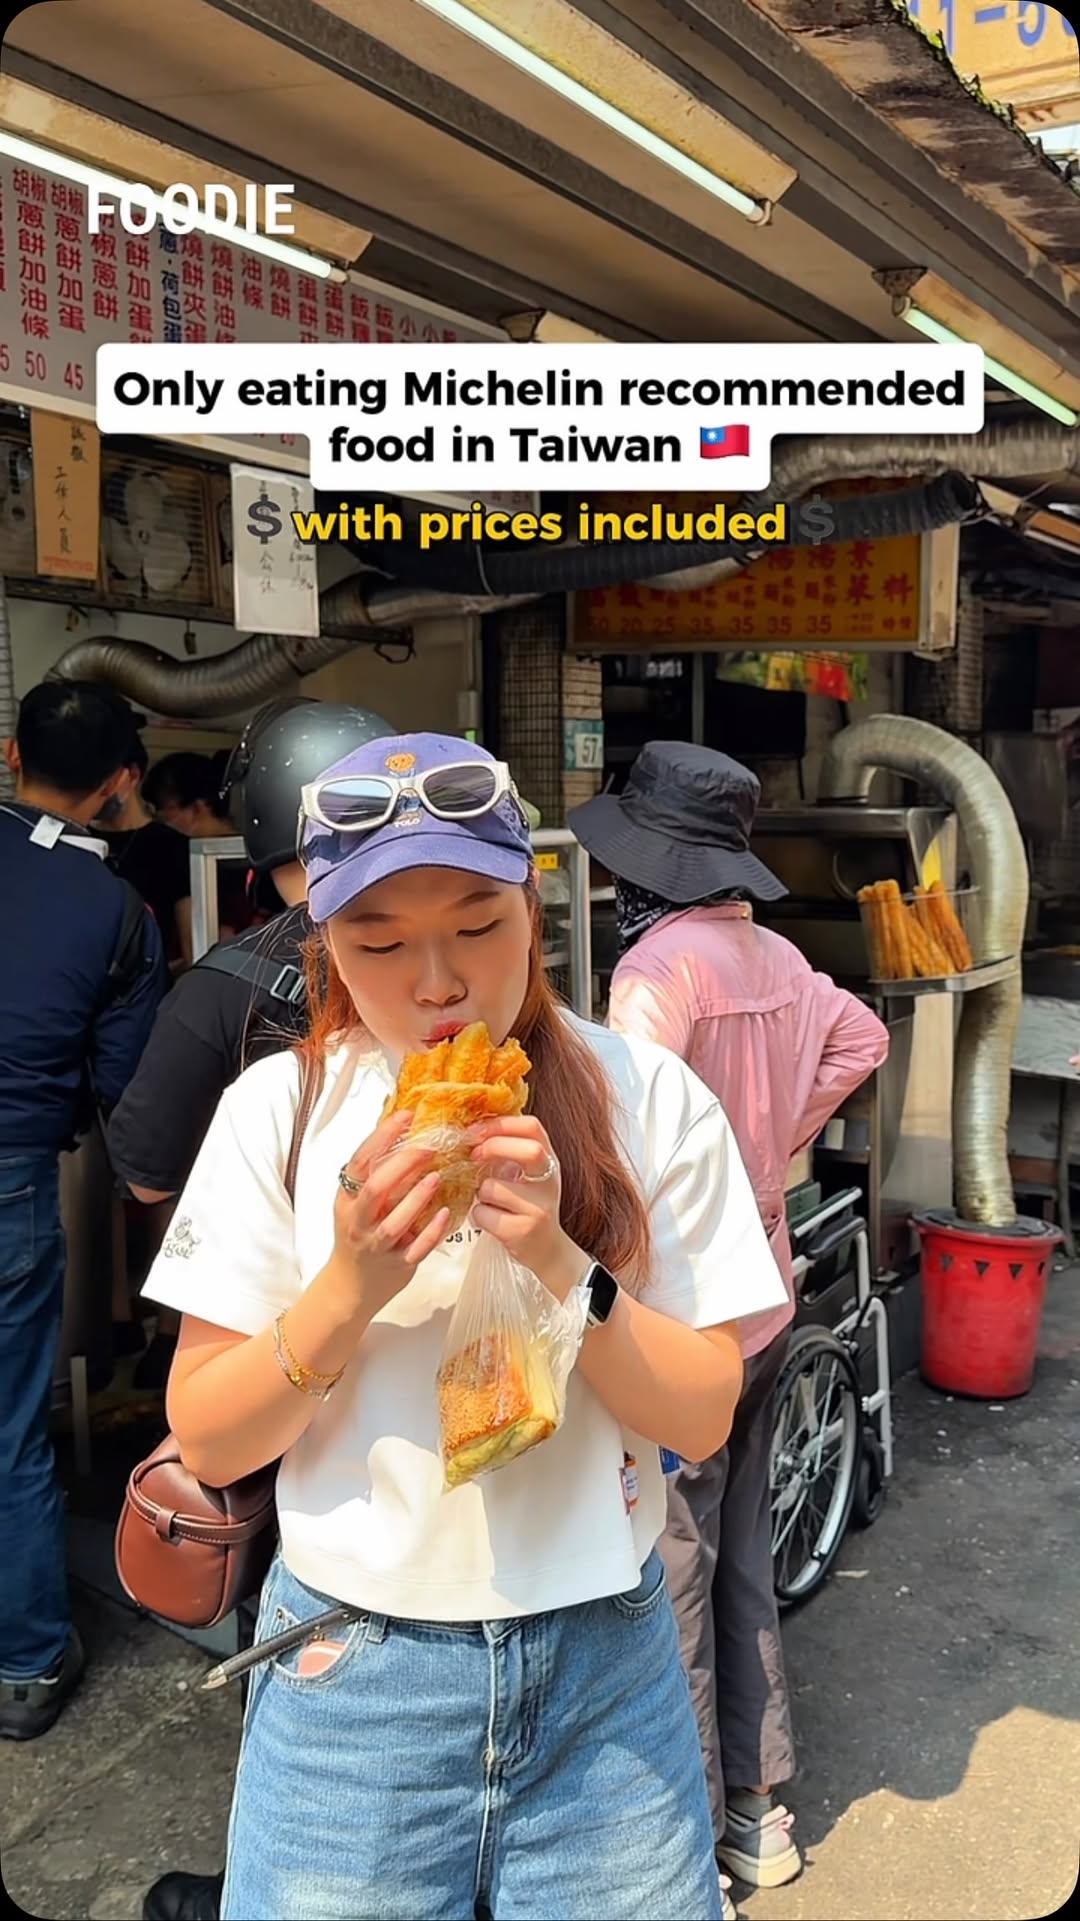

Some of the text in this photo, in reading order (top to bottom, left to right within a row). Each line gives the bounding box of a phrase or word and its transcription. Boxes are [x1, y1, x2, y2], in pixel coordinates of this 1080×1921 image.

[241, 252, 264, 310] 油條
[25, 351, 46, 381] 50
[64, 363, 84, 391] 45
[768, 616, 793, 634] 35
[807, 616, 832, 634] 35
